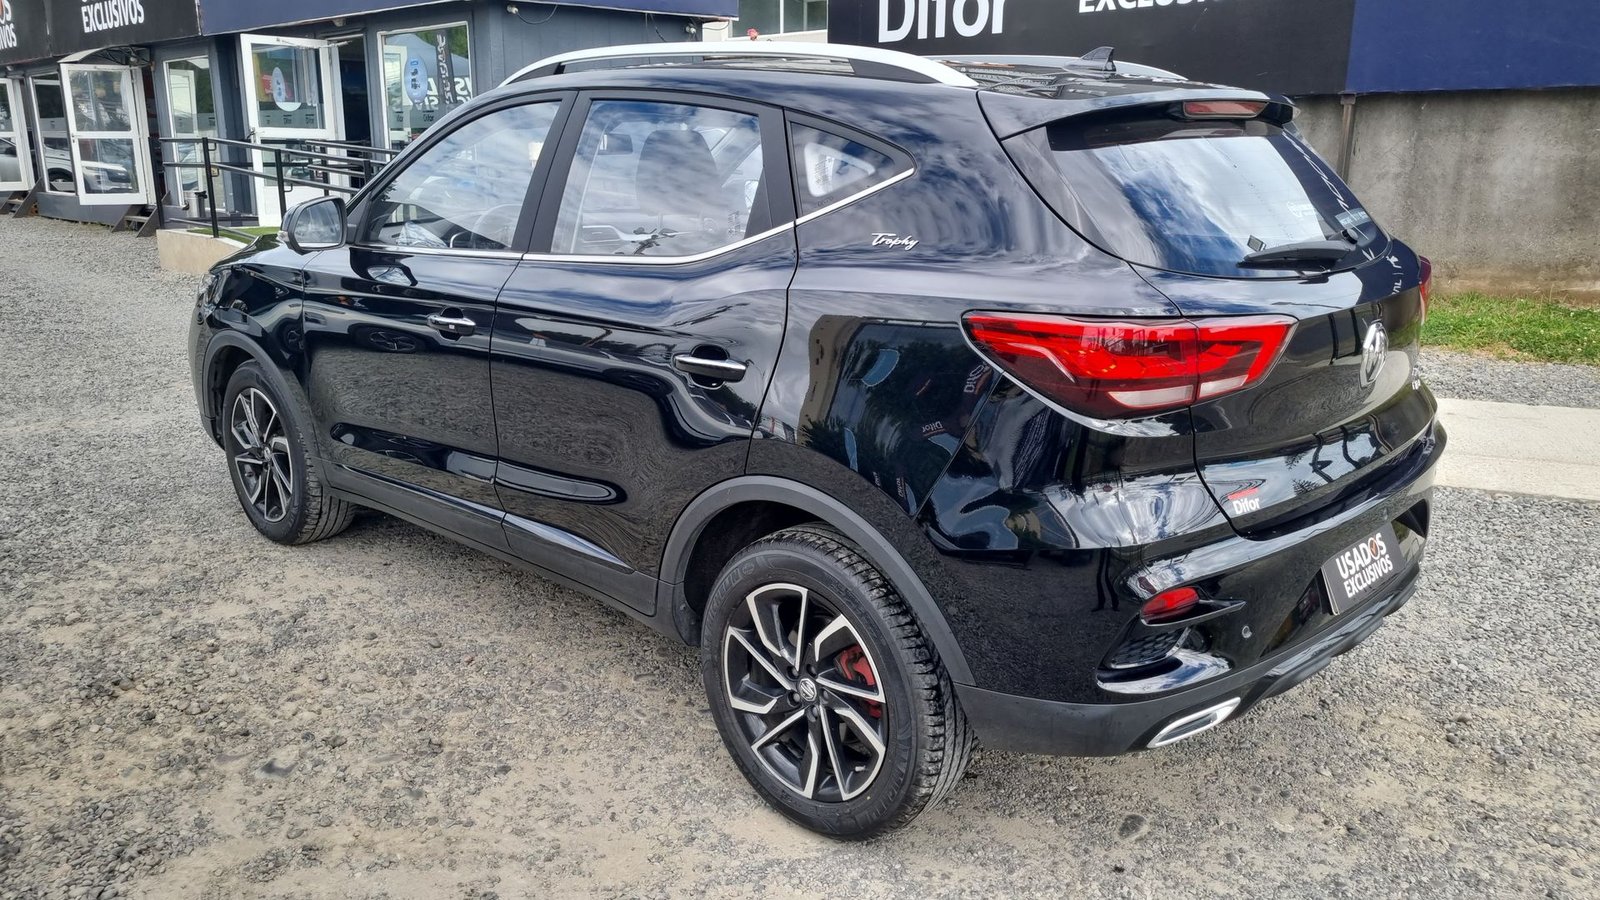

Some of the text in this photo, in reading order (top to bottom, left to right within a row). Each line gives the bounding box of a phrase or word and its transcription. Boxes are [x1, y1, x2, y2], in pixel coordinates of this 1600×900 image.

[82, 0, 144, 33] EXCLUSIVOS
[871, 233, 919, 251] Trophy
[1232, 497, 1260, 515] Difor
[1336, 532, 1387, 579] USADOS
[1343, 555, 1393, 598] EXCLUSIVOS
